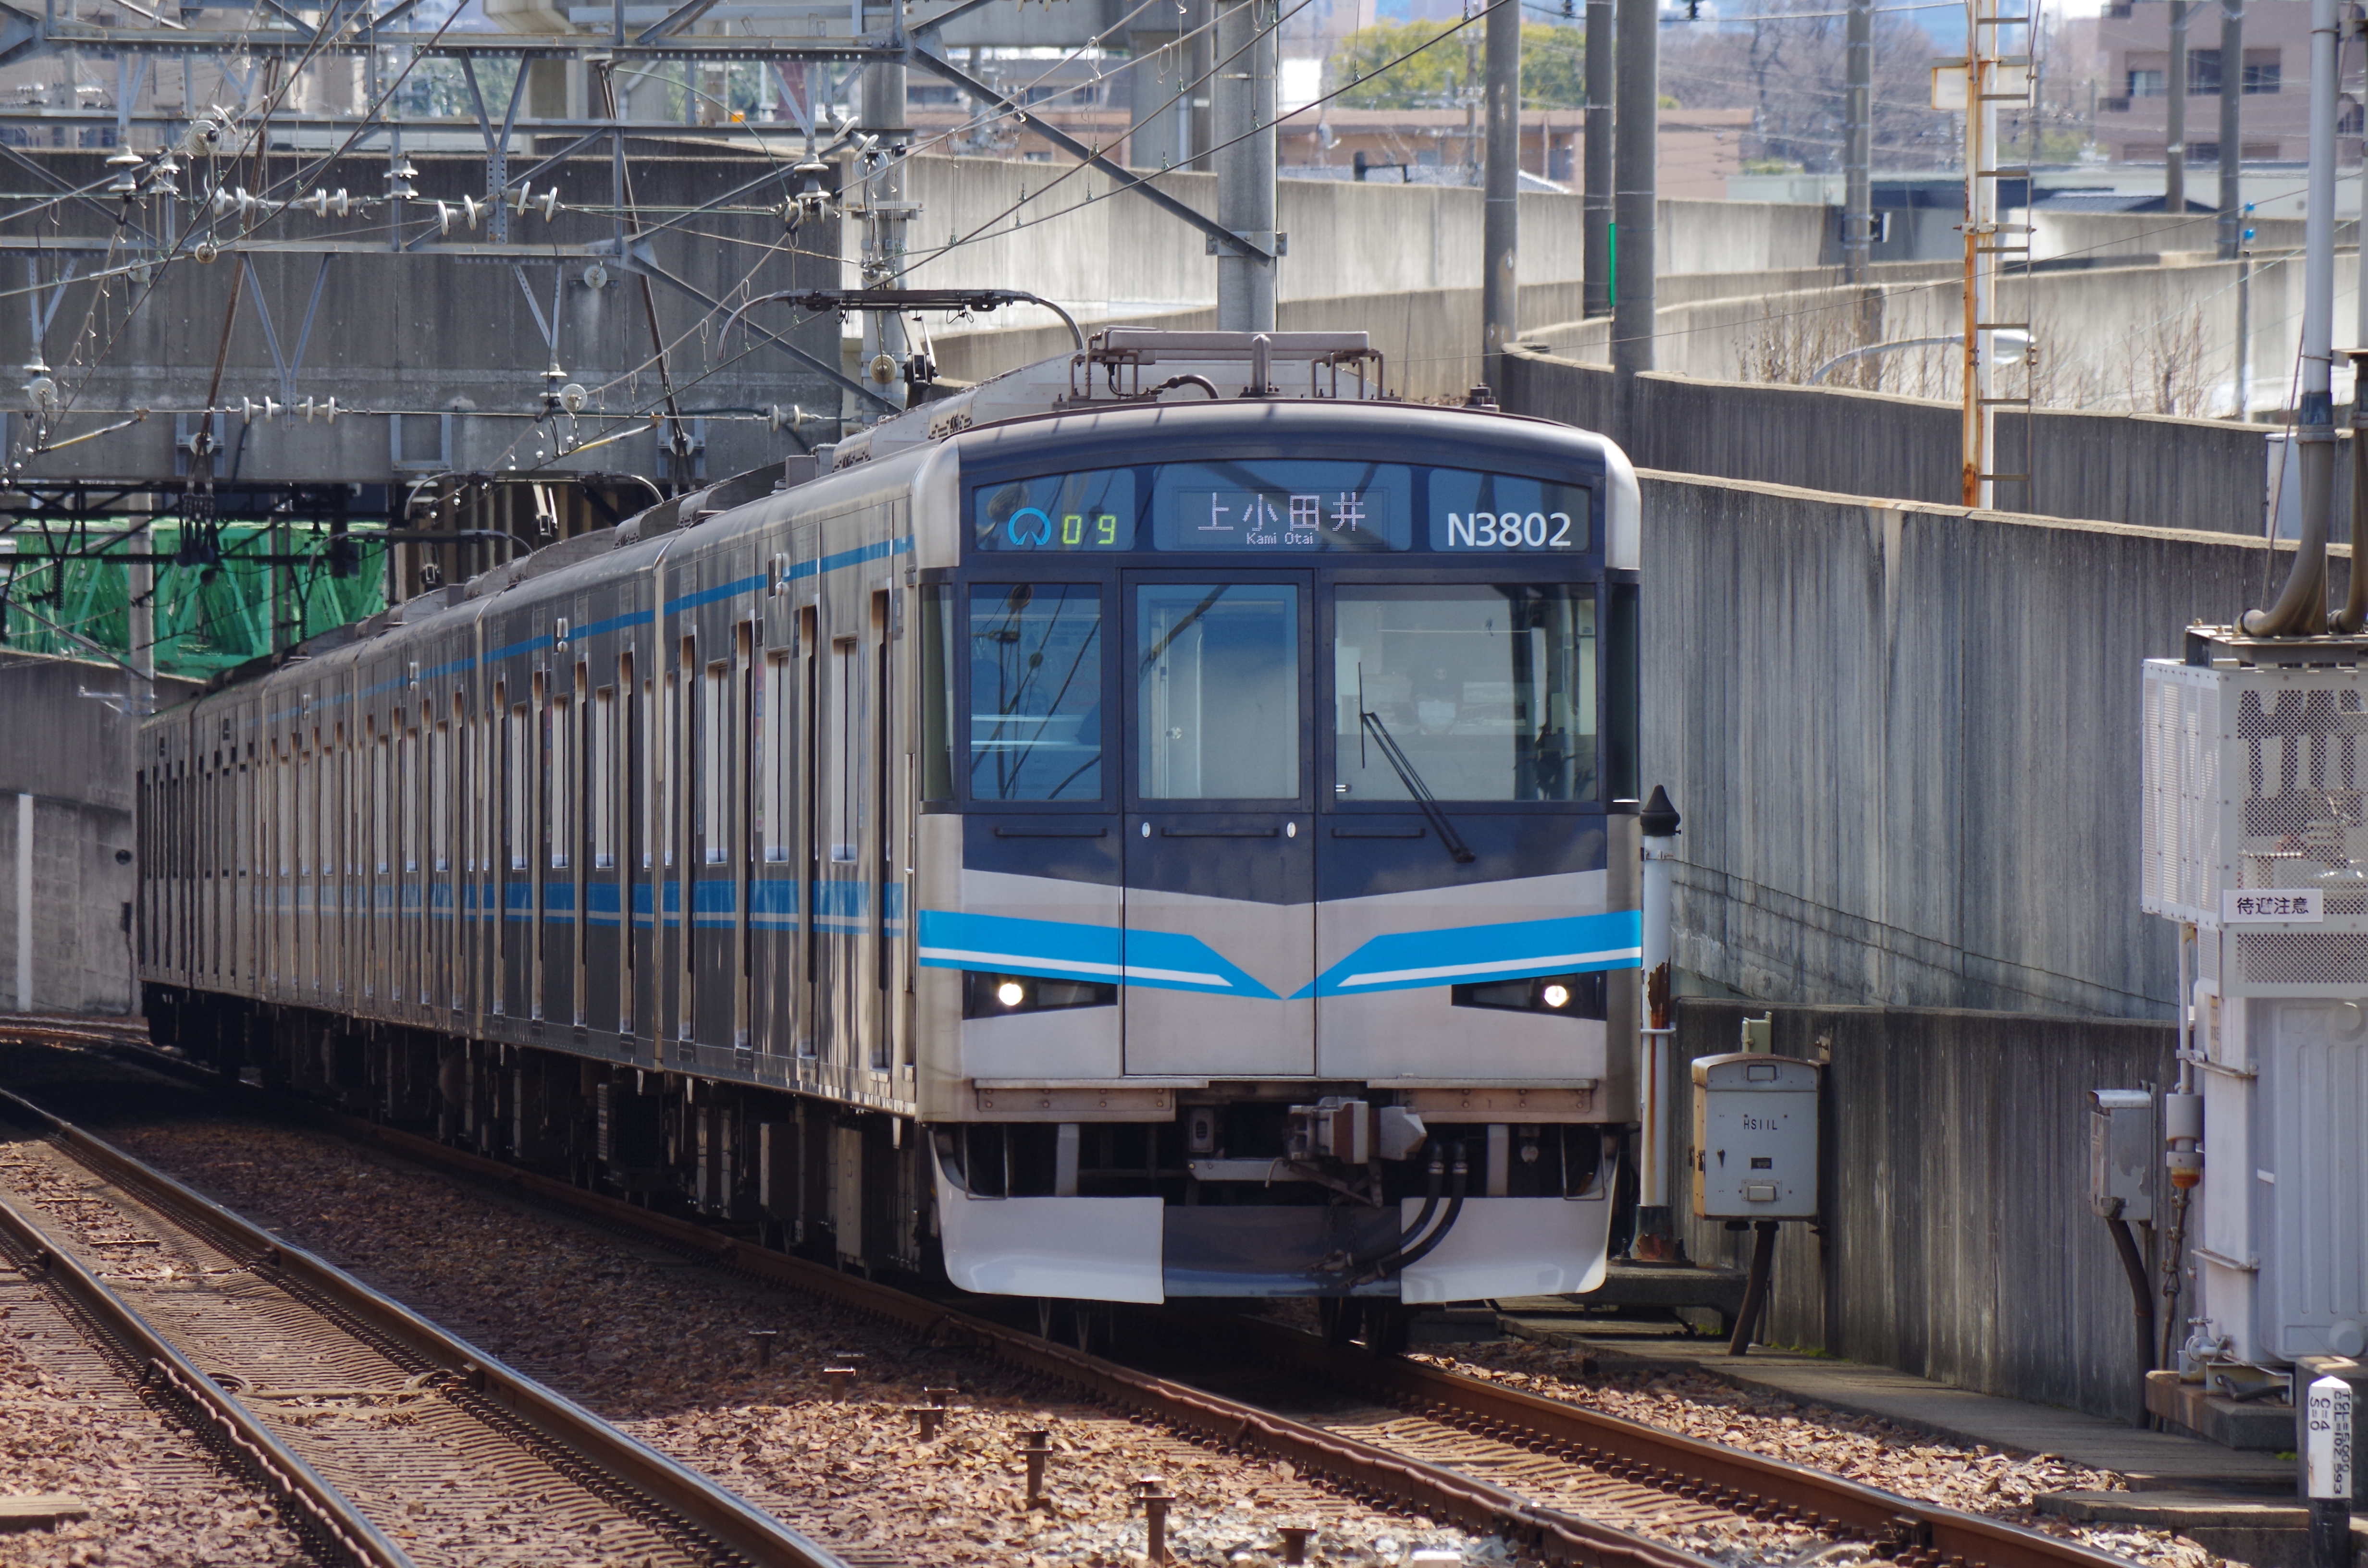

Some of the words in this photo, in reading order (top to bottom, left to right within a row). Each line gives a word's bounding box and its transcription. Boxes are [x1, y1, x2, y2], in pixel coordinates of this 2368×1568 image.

[1198, 491, 1366, 531] 上小田井
[1062, 515, 1116, 544] 09
[1246, 532, 1277, 545] Kami
[1284, 532, 1313, 545] Otai
[1448, 512, 1571, 547] N3802
[2237, 897, 2309, 915] 待避注意
[2320, 1397, 2331, 1431] C=4
